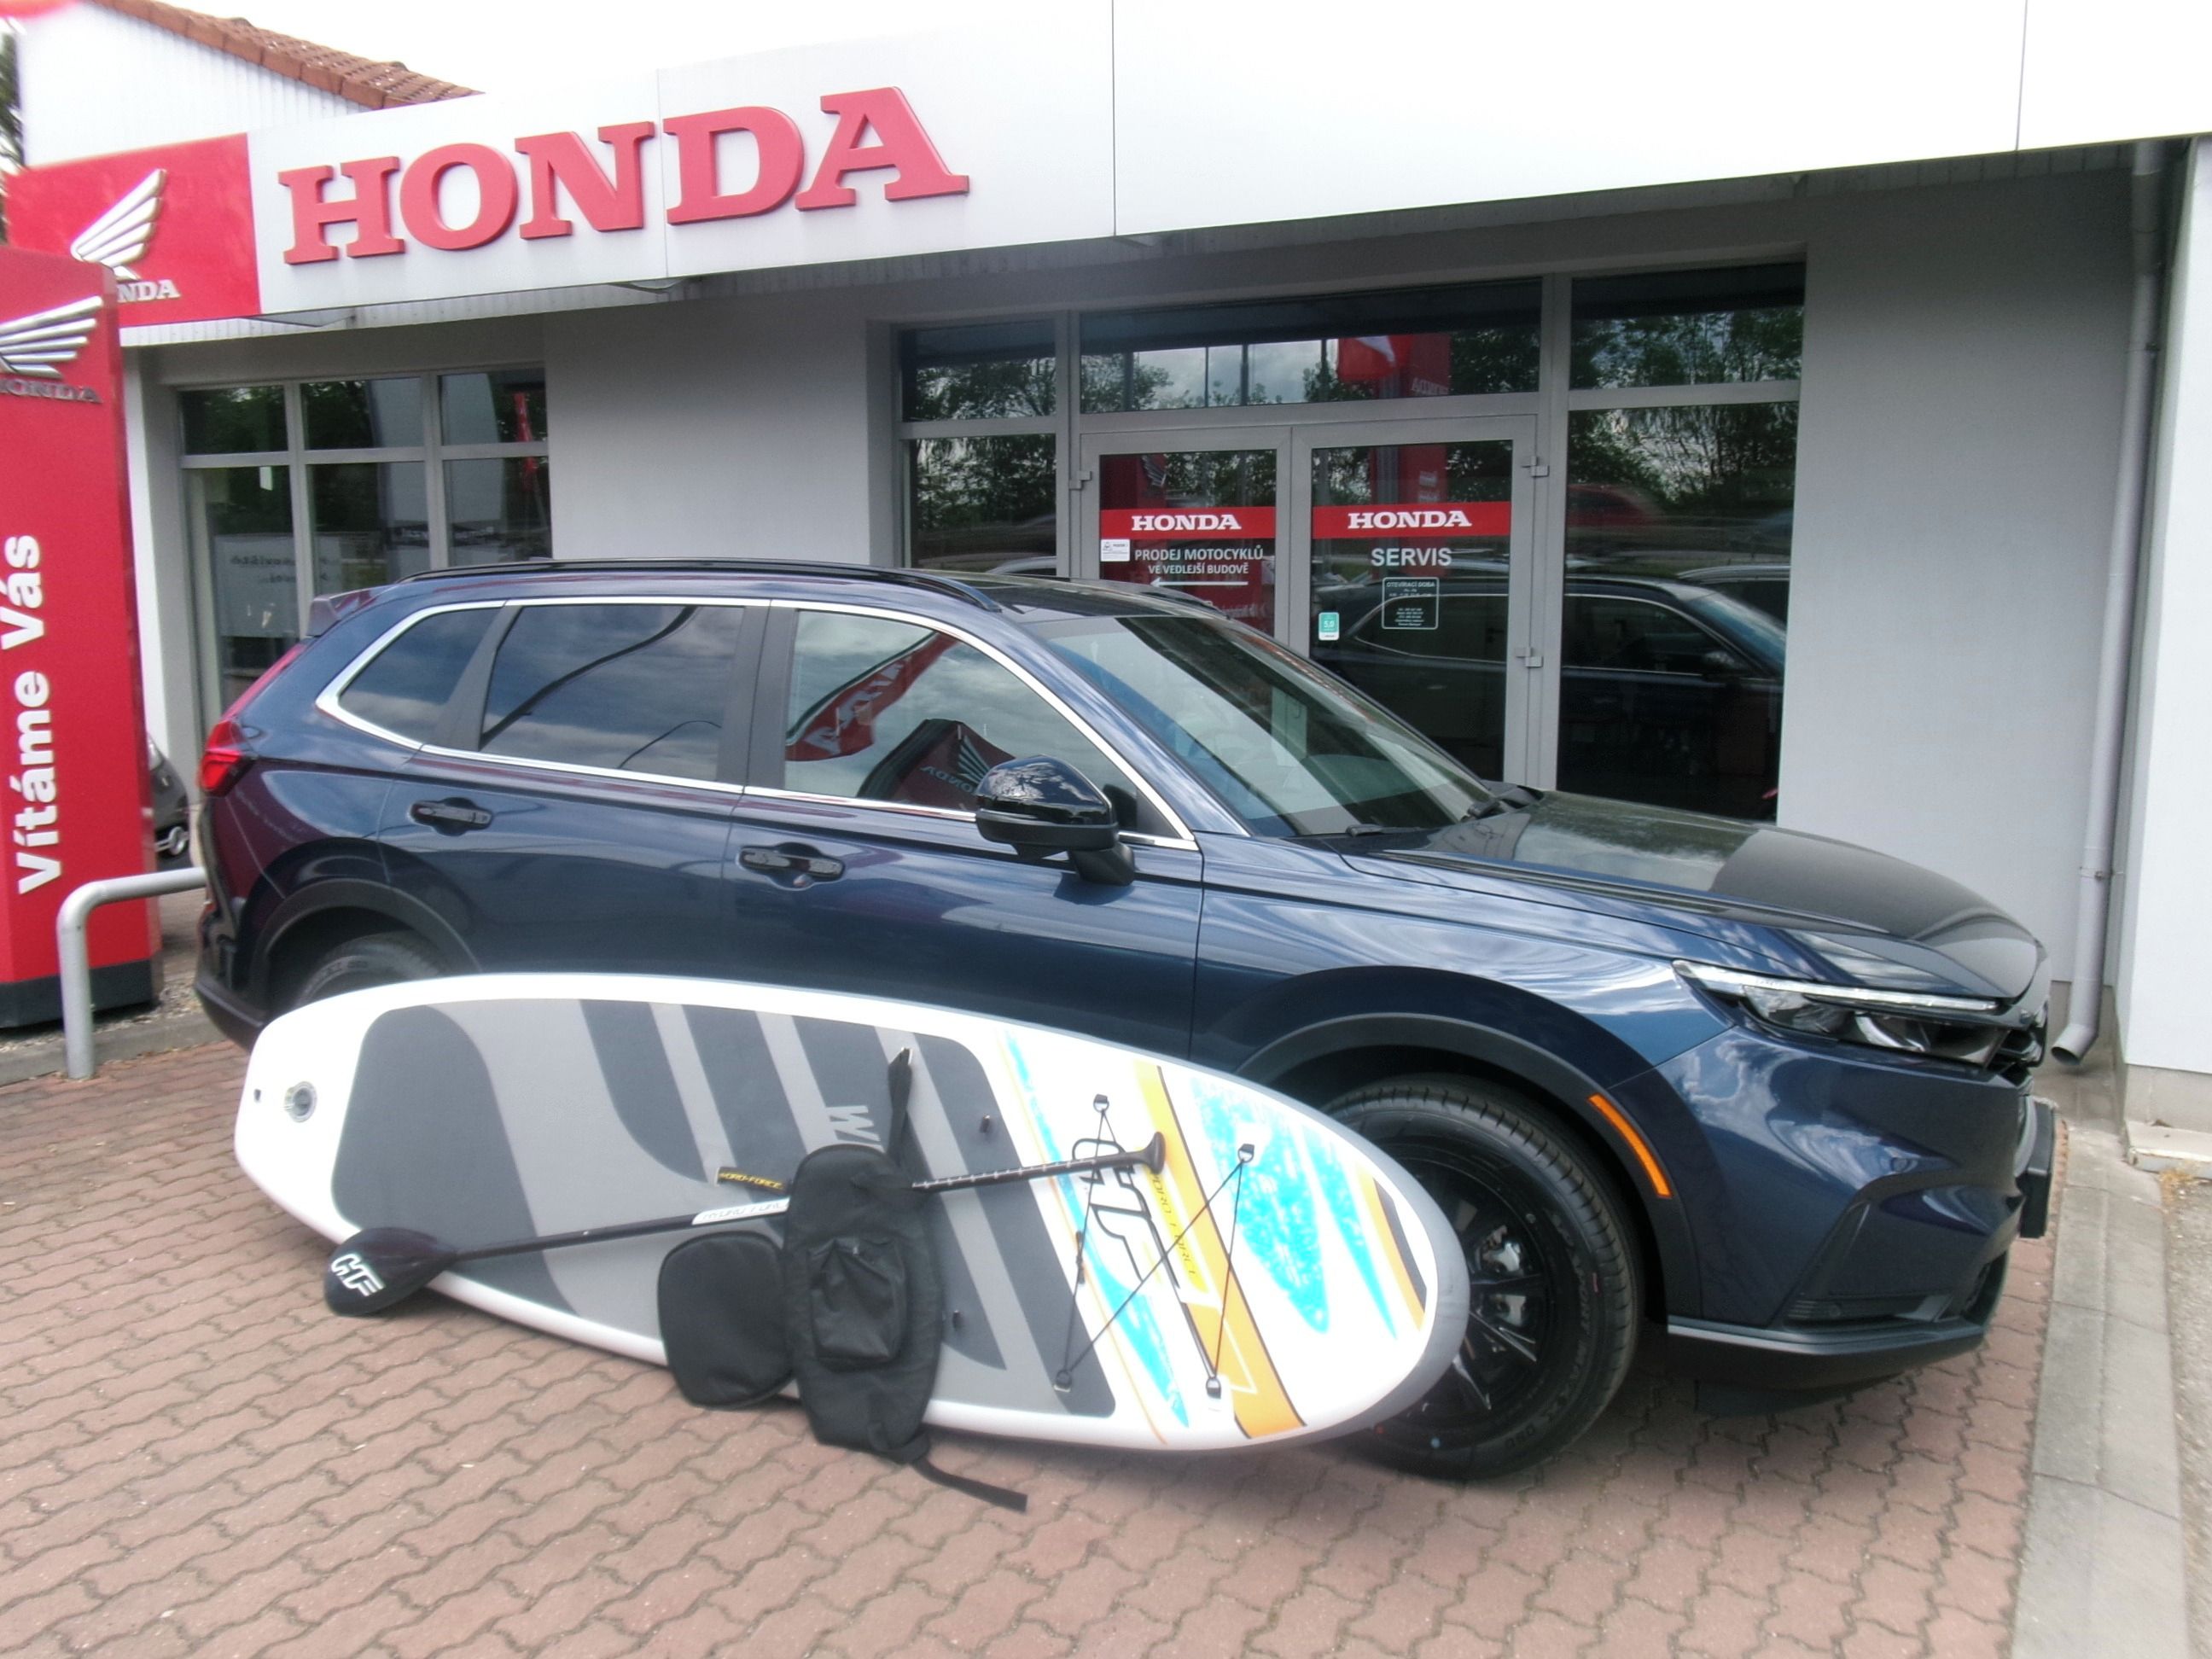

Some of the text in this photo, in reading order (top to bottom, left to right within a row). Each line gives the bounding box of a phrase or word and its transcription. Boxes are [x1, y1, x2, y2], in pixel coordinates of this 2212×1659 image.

[276, 85, 970, 265] HONDA
[118, 278, 181, 304] NDA
[1131, 514, 1243, 533] HONDA
[1347, 509, 1473, 530] HONDA
[1134, 549, 1181, 562] PRODEJ
[1184, 544, 1264, 561] MOTOCYKLŮ
[1370, 546, 1452, 568] SERVIS
[1148, 562, 1249, 575] VE VEDLEJŠÍ BUDOVĚ
[0, 534, 62, 895] Vítáme Vás
